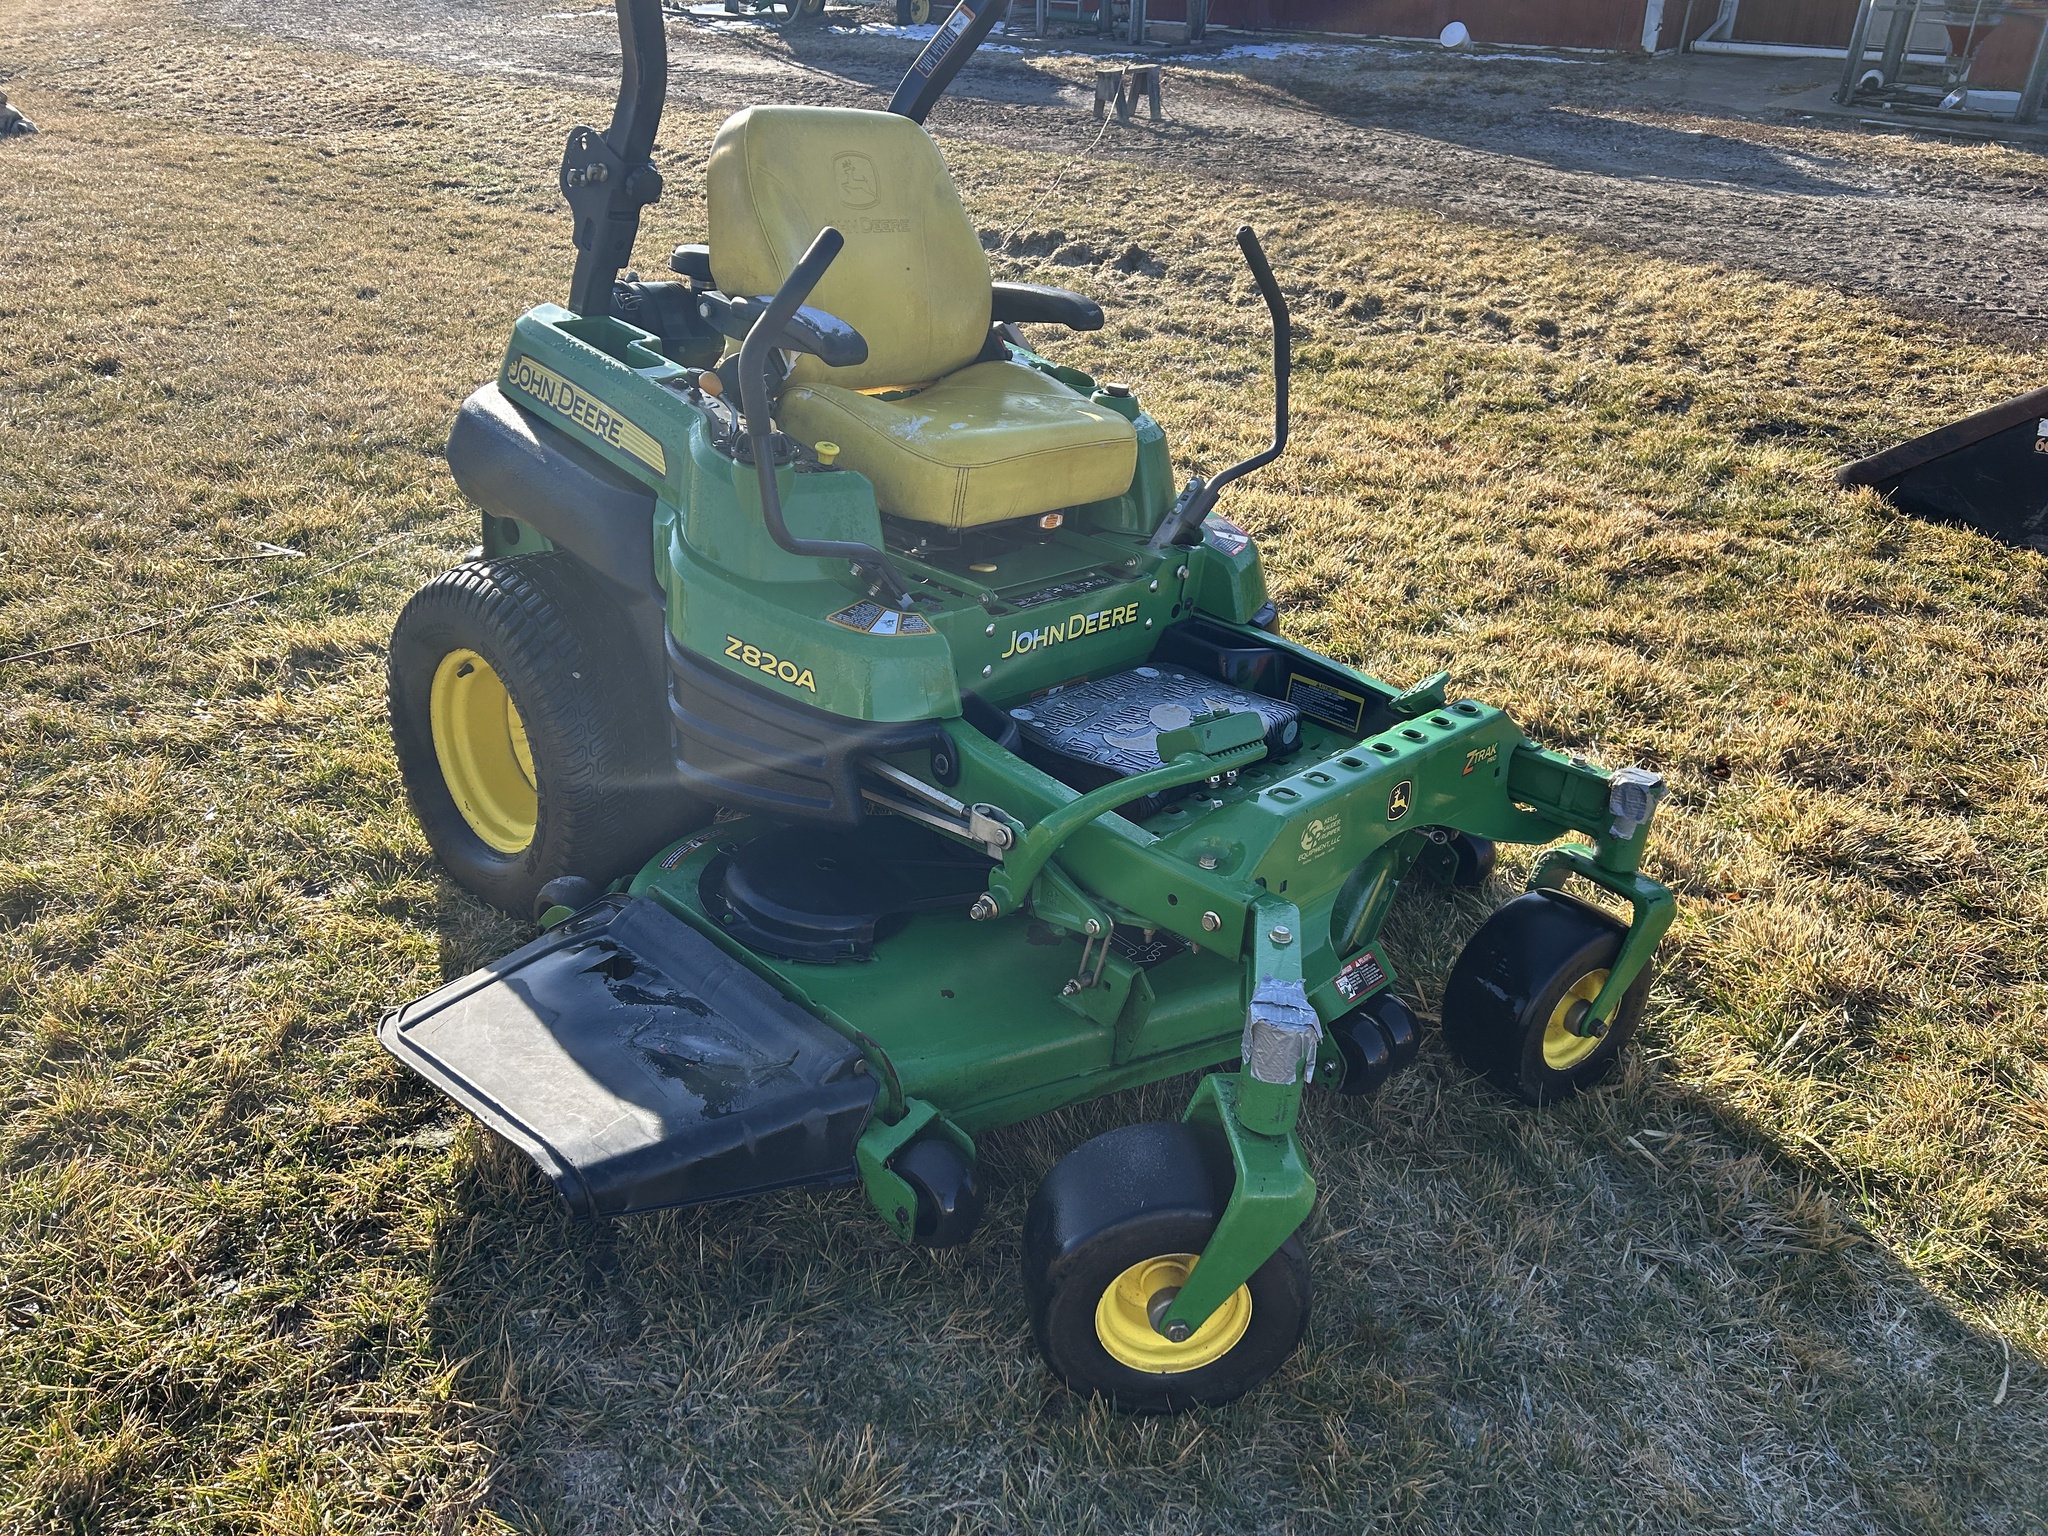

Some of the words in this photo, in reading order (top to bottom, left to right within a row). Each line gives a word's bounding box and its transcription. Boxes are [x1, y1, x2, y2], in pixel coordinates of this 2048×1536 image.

[859, 216, 911, 233] DEERE
[509, 361, 556, 405] JOHN
[557, 382, 624, 444] DEERE
[1001, 622, 1066, 659] JOHN
[1067, 602, 1139, 640] DEERE
[724, 635, 816, 693] Z820A
